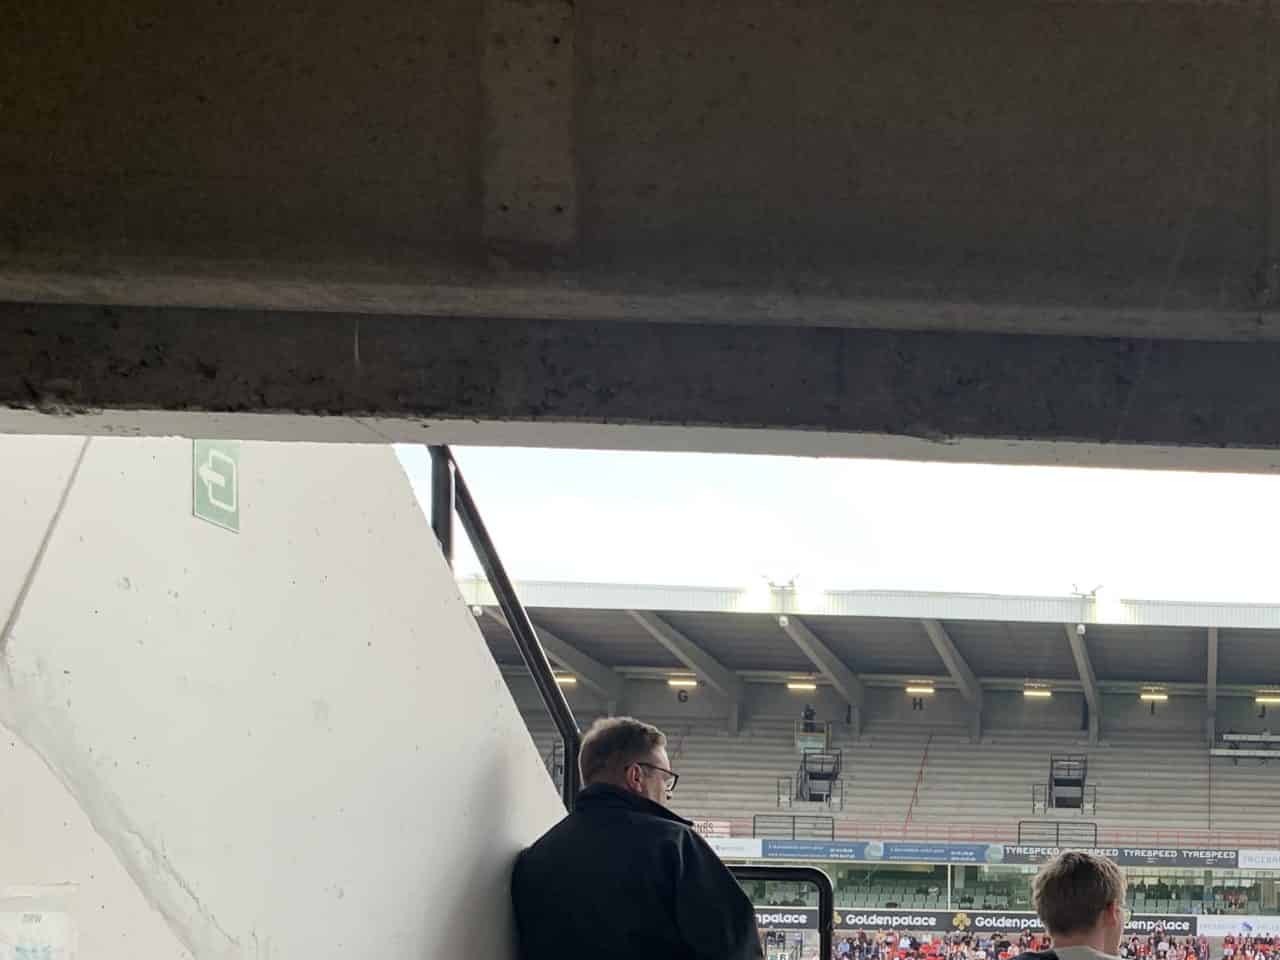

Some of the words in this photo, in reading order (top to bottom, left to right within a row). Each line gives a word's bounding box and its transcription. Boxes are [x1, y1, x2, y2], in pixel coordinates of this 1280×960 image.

[913, 697, 923, 711] H
[1006, 847, 1059, 857] TYRESPEED
[1124, 849, 1177, 858] TYRESPEED
[1182, 850, 1236, 859] TYRESPEED
[846, 913, 937, 927] Goldenpalace
[975, 916, 1044, 928] Goldenpal
